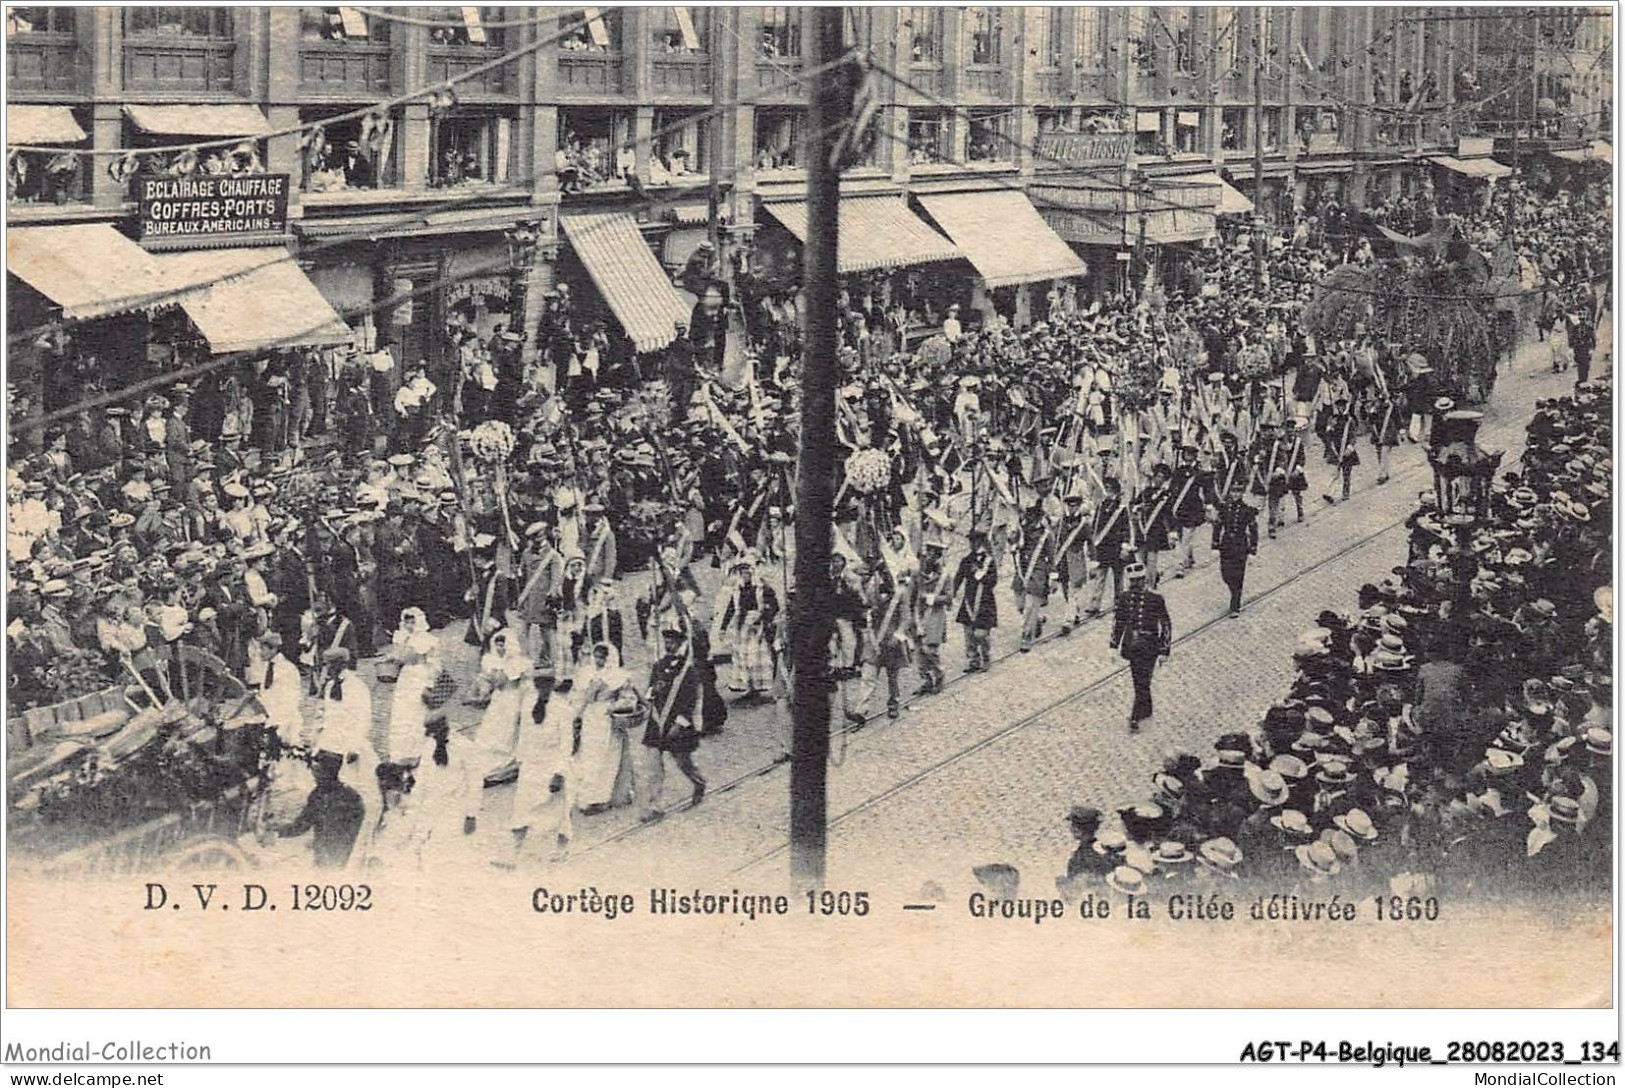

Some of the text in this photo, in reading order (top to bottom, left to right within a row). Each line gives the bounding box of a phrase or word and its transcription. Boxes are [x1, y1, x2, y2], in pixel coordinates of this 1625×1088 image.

[145, 178, 283, 199] ECLAIRAGE CHAUFFAGE
[145, 217, 270, 235] BUREAUX AMÉRICAINS
